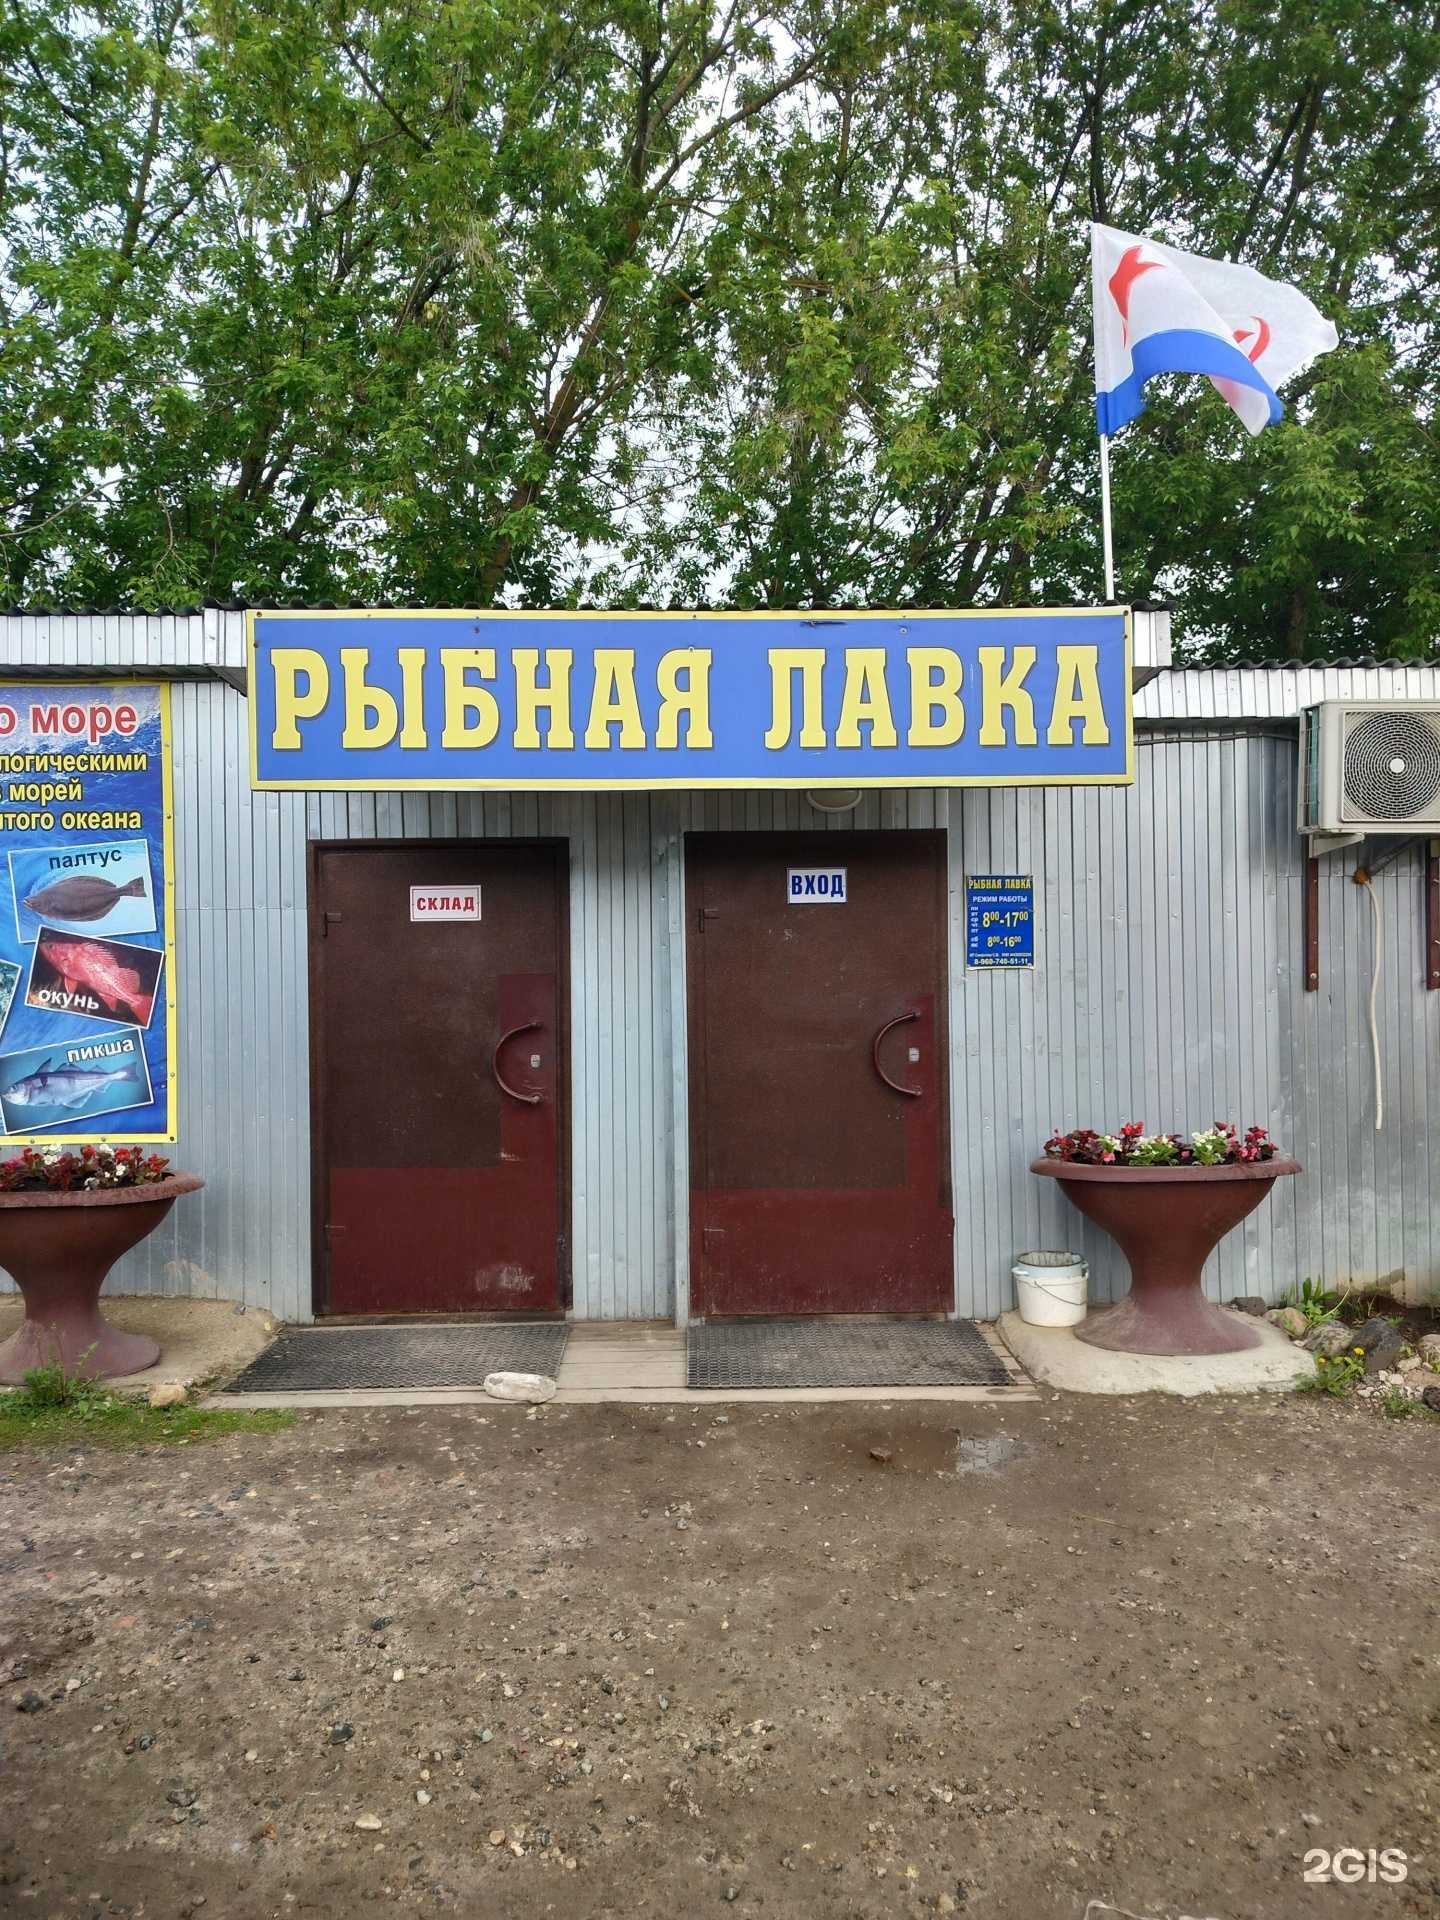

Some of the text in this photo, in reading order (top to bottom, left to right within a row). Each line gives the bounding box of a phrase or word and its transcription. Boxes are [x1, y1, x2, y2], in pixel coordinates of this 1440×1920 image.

[270, 645, 1111, 749] РЫБНАЯ ЛАВКА
[31, 705, 137, 743] море
[9, 778, 82, 806] морей
[61, 811, 142, 830] океана
[49, 849, 122, 870] палтус
[791, 874, 844, 897] ВХОД
[968, 879, 1031, 889] РЫБНАЯ ЛАВКА
[416, 896, 475, 912] СКЛАД
[999, 895, 1028, 903] РАБОТЫ
[38, 989, 100, 1011] окунь
[66, 1038, 135, 1063] пикша
